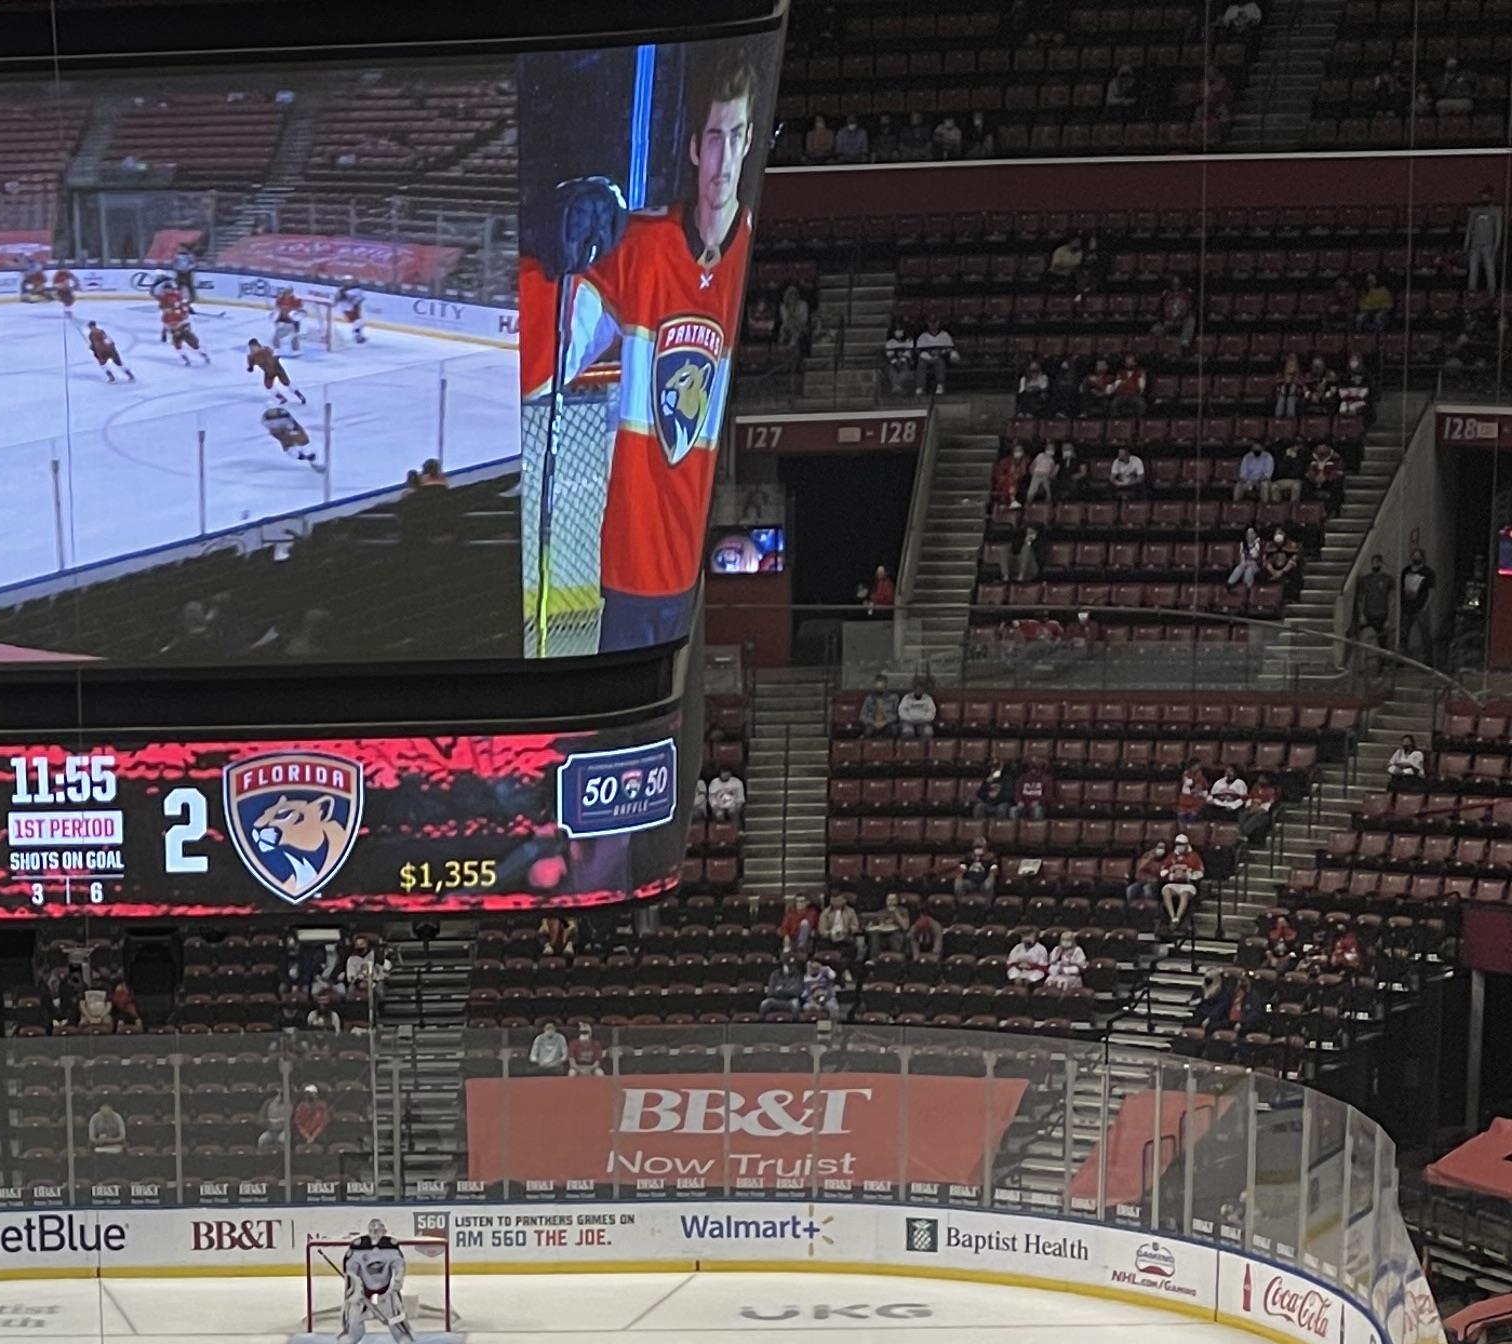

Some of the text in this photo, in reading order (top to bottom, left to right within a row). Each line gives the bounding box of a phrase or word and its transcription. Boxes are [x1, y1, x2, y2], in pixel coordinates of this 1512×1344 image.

[413, 299, 465, 321] CITY
[745, 427, 783, 449] 127
[880, 421, 917, 444] 128
[9, 755, 117, 804] 11:55
[242, 768, 346, 791] FLORIDA
[582, 765, 668, 806] 50 50
[14, 817, 116, 839] 1ST PERIOD
[163, 787, 209, 873] 2
[9, 850, 125, 869] SHOTS ON GOAL
[399, 860, 498, 898] $1,355
[31, 883, 44, 904] 3
[90, 882, 104, 904] 6
[609, 1088, 873, 1137] BB&T
[606, 1150, 857, 1177] Now Truist
[417, 1214, 447, 1230] 560
[455, 1213, 636, 1227] LISTEN TO PANTHERS GAMES ON
[191, 1219, 283, 1251] BB&T
[455, 1228, 613, 1248] AM 560 THE JOE.
[945, 1226, 1090, 1262] Baptist Health
[738, 1303, 935, 1321] UKG
